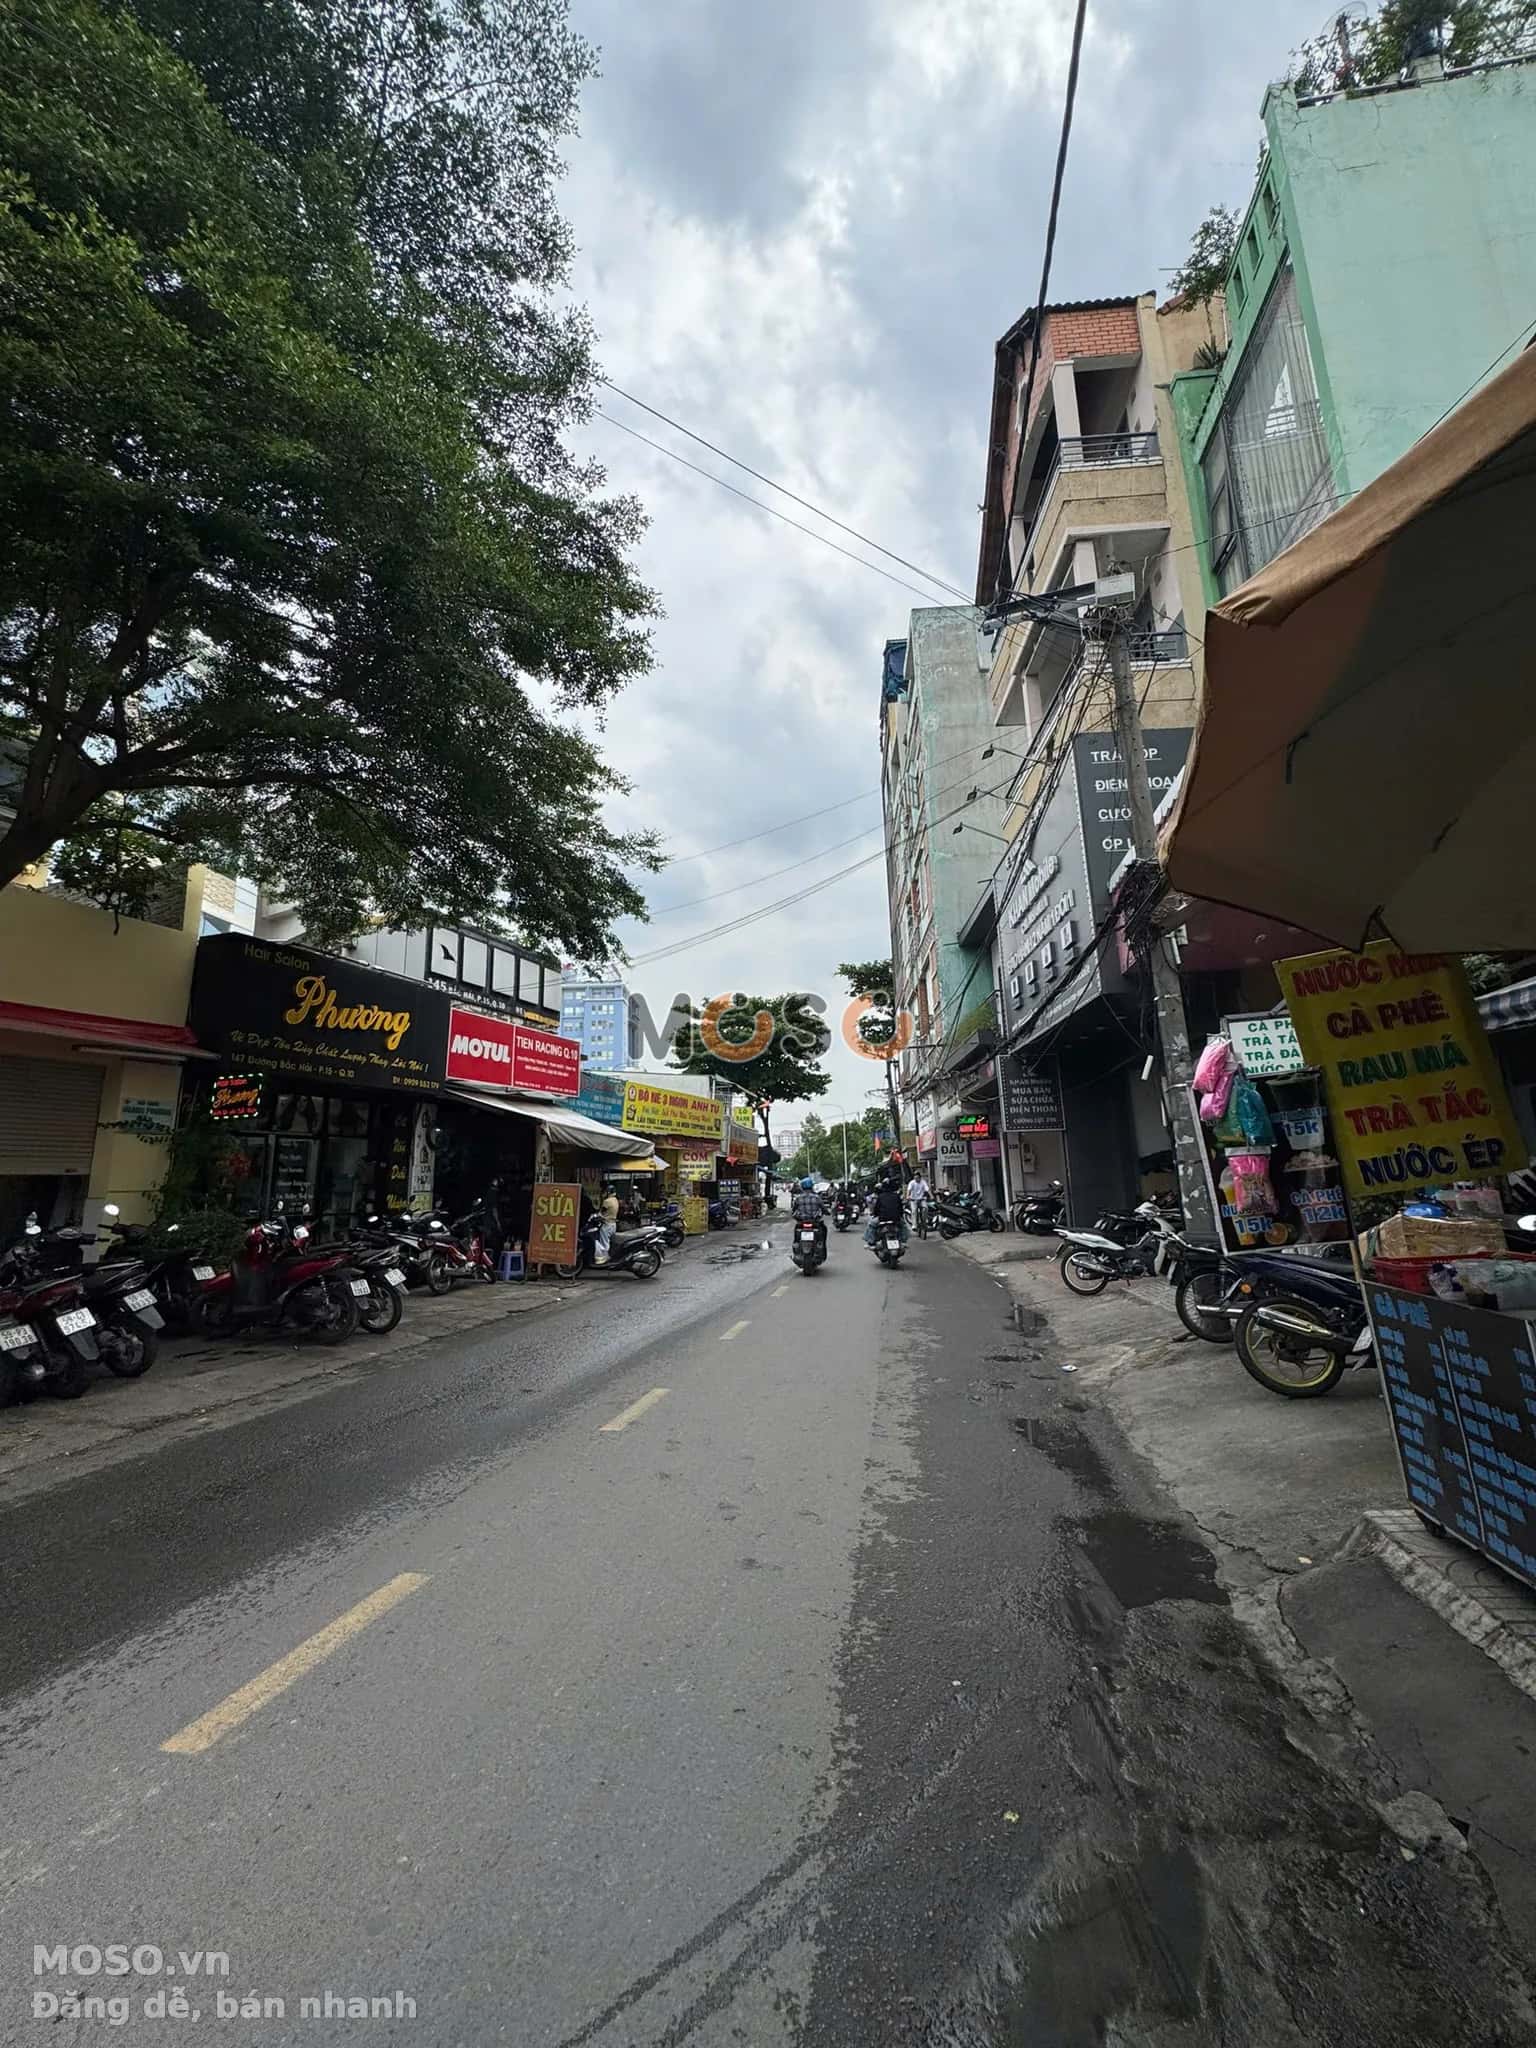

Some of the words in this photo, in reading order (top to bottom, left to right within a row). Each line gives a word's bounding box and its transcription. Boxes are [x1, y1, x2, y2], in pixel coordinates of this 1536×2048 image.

[245, 943, 270, 961] Hair
[274, 949, 312, 971] Salon
[286, 974, 412, 1051] Phương
[1248, 1018, 1268, 1033] CÀ
[1326, 1001, 1375, 1039] CÀ
[451, 1034, 512, 1064] MOTUL
[535, 1040, 563, 1057] RACING
[1242, 1033, 1273, 1048] TRÀ
[1244, 1047, 1275, 1062] TRÀ
[1337, 1051, 1409, 1087] RAU
[1412, 1034, 1471, 1074] MÁ
[1344, 1094, 1419, 1137] TRÀ
[1418, 1080, 1492, 1124] TẮC
[1357, 1142, 1458, 1187] NƯỚC
[535, 1188, 575, 1218] SỬA
[541, 1223, 567, 1243] XE
